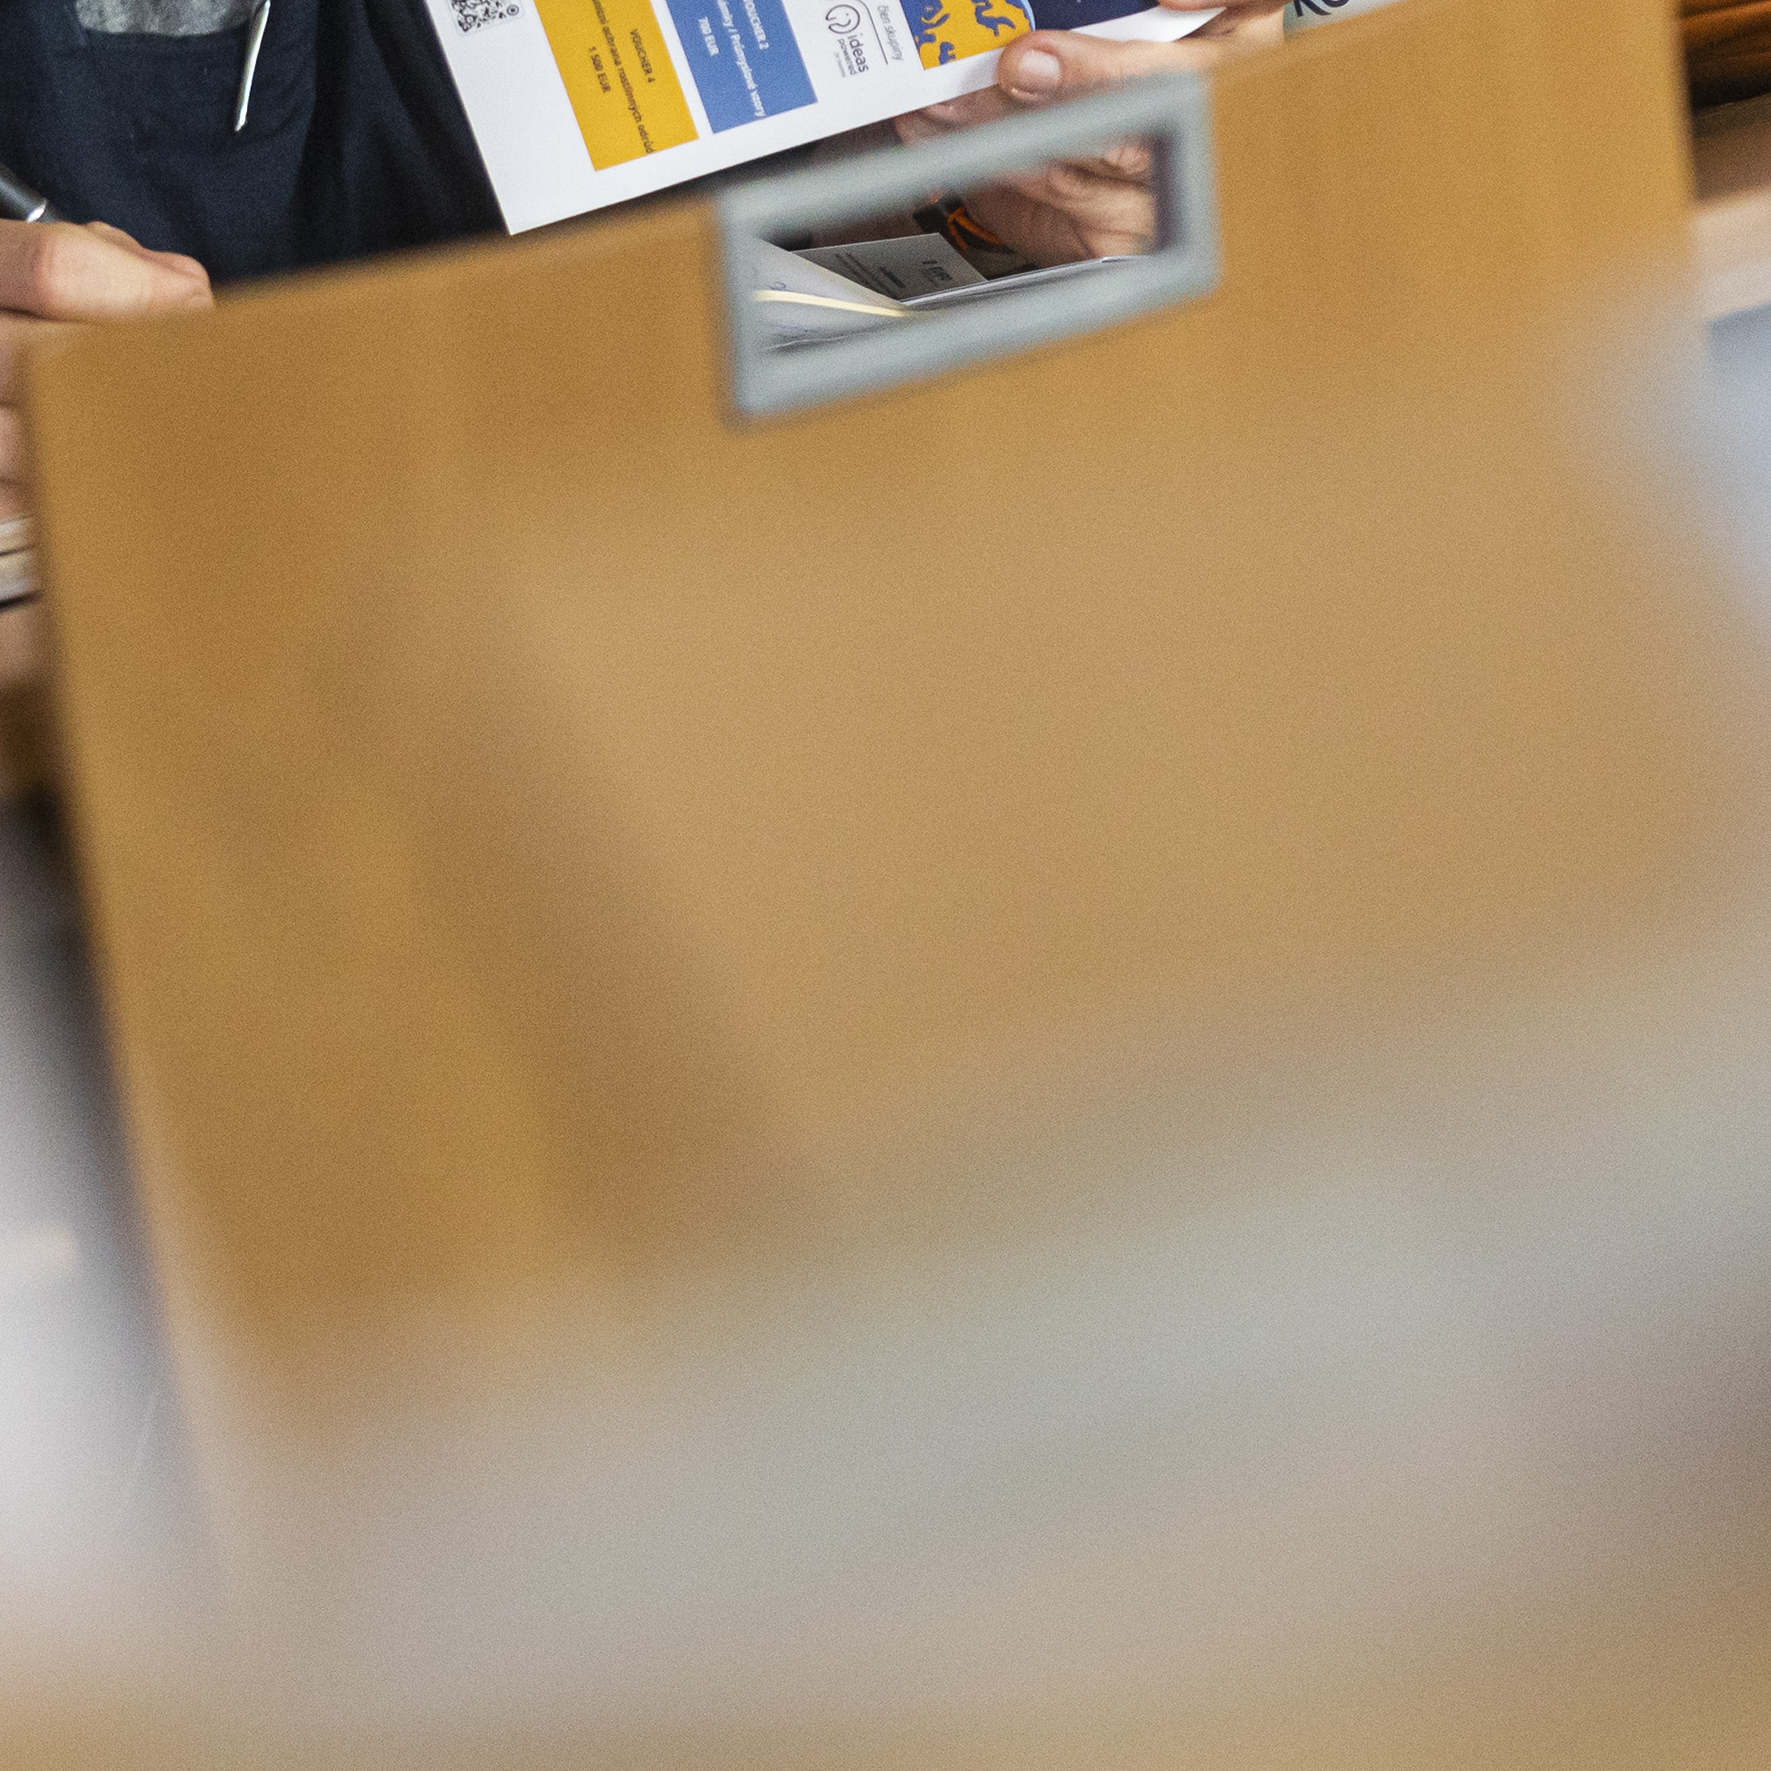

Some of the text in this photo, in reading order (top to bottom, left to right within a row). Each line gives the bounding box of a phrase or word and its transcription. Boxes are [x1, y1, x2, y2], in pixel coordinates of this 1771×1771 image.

[601, 25, 622, 66] ochrana
[629, 28, 653, 76] VOUCHER
[704, 34, 720, 56] EUR
[758, 41, 769, 51] 2
[837, 38, 856, 76] powered
[847, 34, 870, 73] ideas
[596, 72, 611, 93] EUR
[749, 89, 767, 118] vzory
